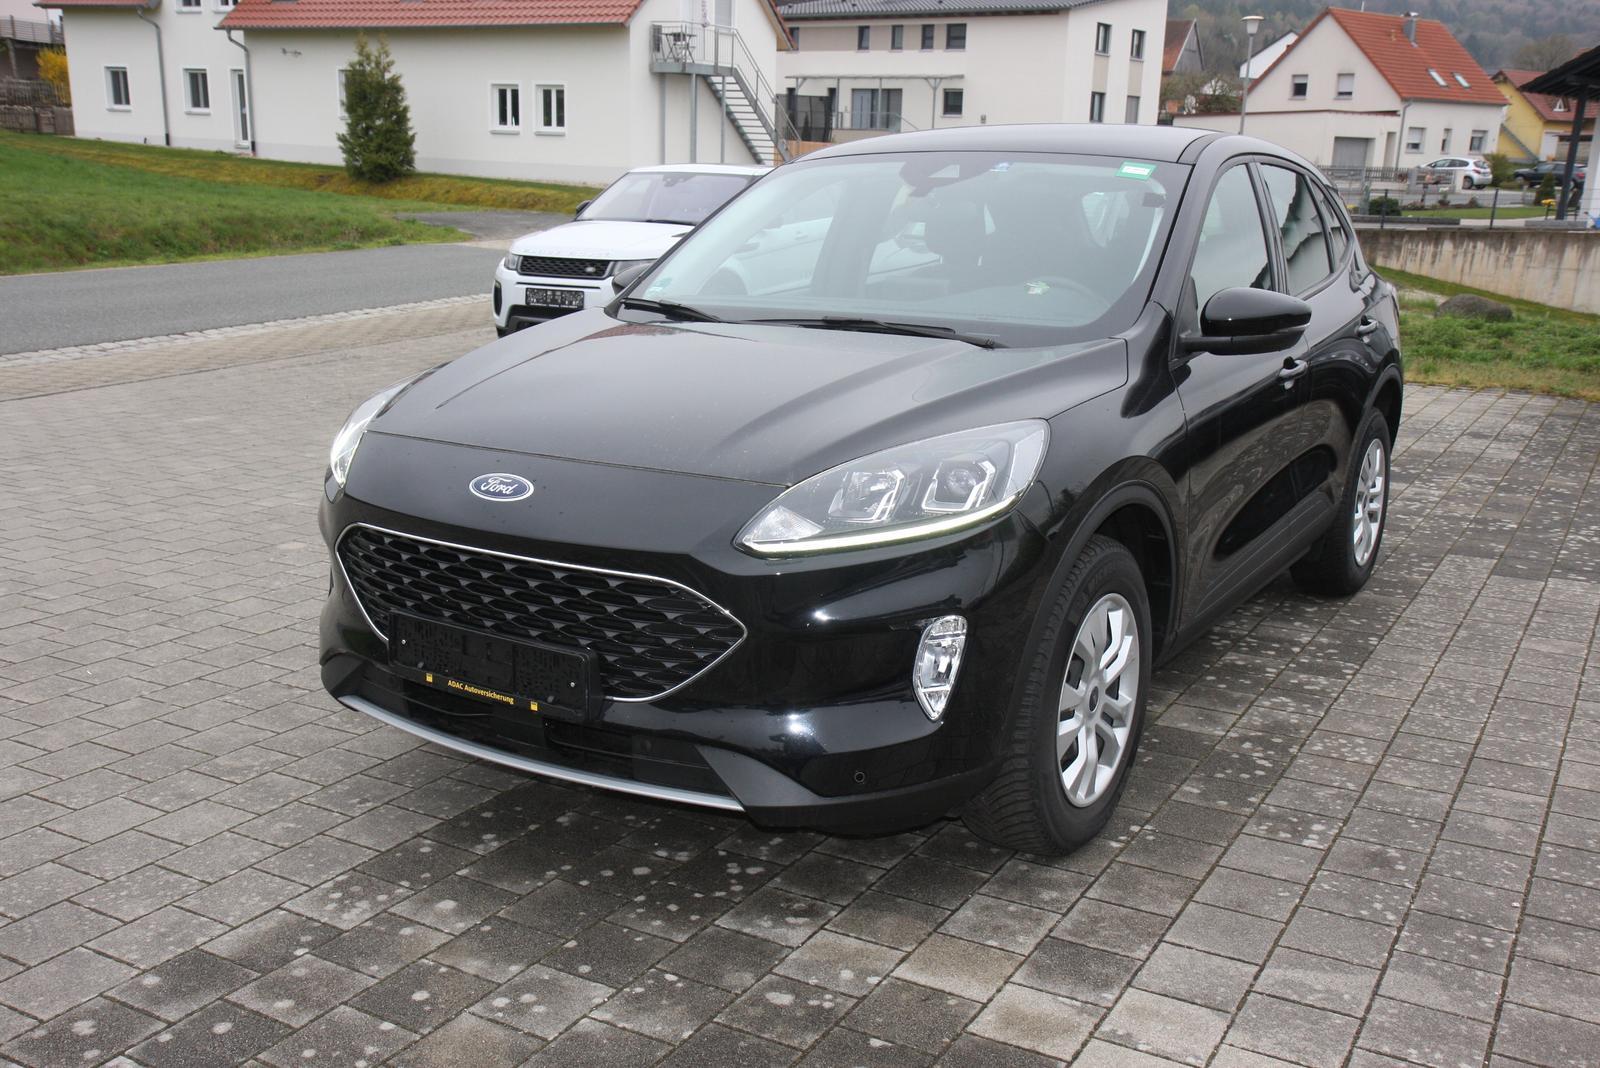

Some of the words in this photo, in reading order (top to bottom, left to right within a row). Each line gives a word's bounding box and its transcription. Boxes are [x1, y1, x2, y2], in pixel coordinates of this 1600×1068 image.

[480, 476, 518, 495] Ford
[447, 679, 464, 690] ADAC
[464, 684, 514, 705] Autoversicherung
